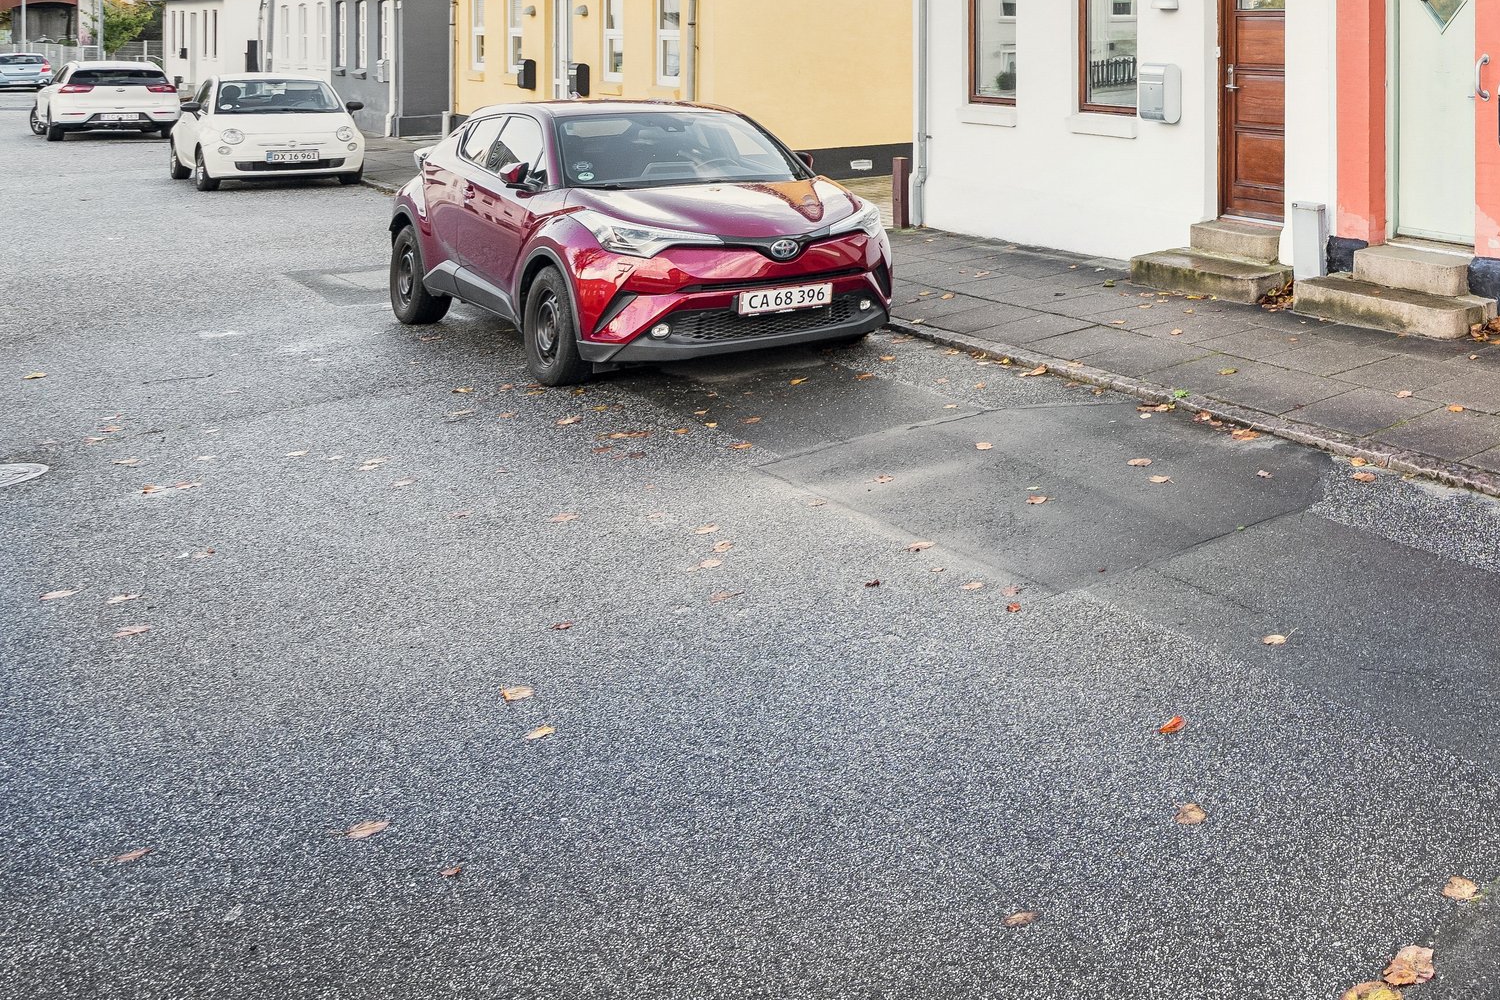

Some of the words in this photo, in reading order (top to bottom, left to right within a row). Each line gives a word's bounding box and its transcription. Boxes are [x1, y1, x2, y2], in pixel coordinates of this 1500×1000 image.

[273, 153, 286, 161] DX
[289, 153, 299, 161] 16
[300, 152, 316, 160] 961
[748, 294, 770, 309] CA
[774, 291, 793, 306] 68
[797, 287, 825, 304] 396
